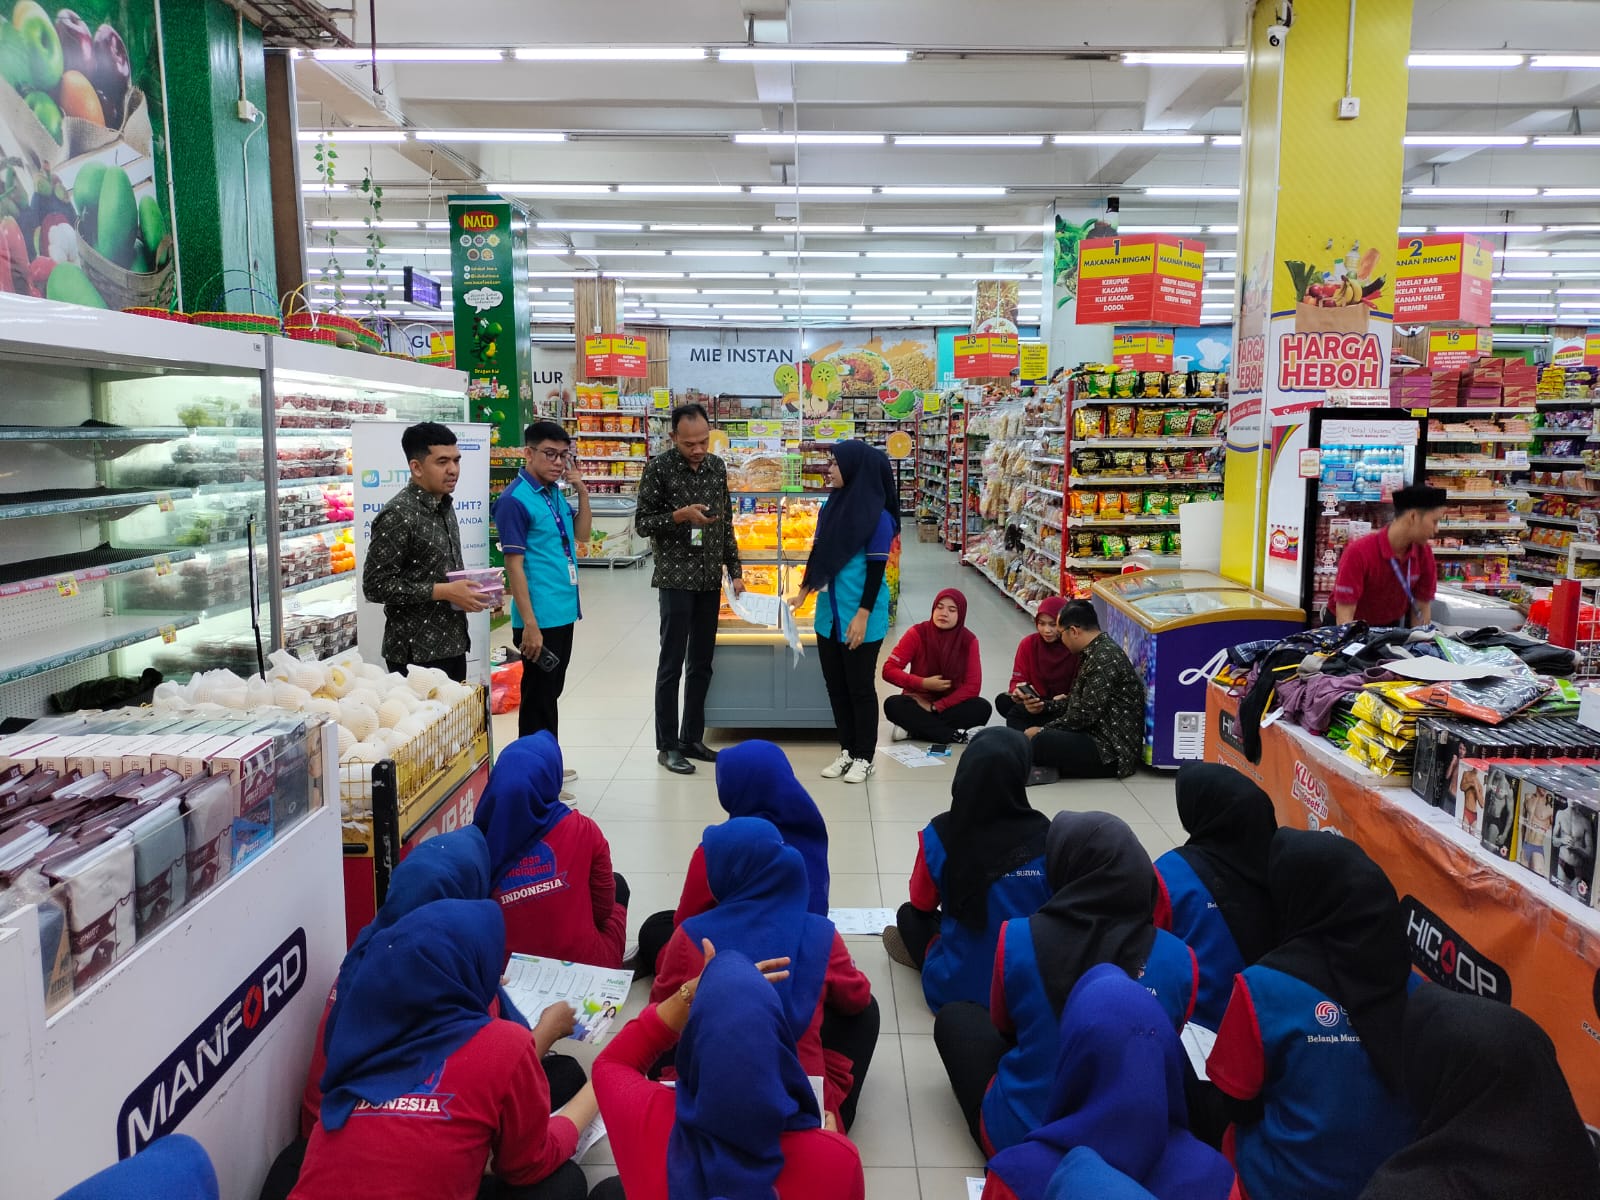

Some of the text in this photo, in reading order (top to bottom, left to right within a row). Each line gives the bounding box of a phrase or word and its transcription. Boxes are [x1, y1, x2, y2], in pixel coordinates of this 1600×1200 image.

[463, 215, 495, 228] INACO
[1113, 239, 1120, 256] 1
[1178, 241, 1183, 258] 1
[1409, 239, 1424, 258] 2
[1083, 255, 1151, 267] MAKANAN RINGAN
[1159, 255, 1201, 270] MAKANAN RINGAN
[1422, 255, 1457, 264] RINGAN
[1102, 286, 1128, 294] KACANG
[1399, 304, 1427, 312] PERMEN
[624, 336, 634, 345] 12
[967, 336, 976, 344] 13
[1122, 335, 1133, 344] 14
[1447, 332, 1460, 341] 16
[1283, 336, 1379, 361] HARGA
[690, 348, 793, 363] MIE INSTAN
[533, 370, 563, 385] LUR
[1282, 363, 1378, 387] HEBOH
[456, 501, 482, 511] JHT?
[460, 517, 483, 525] ANDA
[500, 878, 564, 905] INDONESIA
[1307, 1034, 1339, 1044] Belanja
[128, 945, 300, 1157] MANFORD
